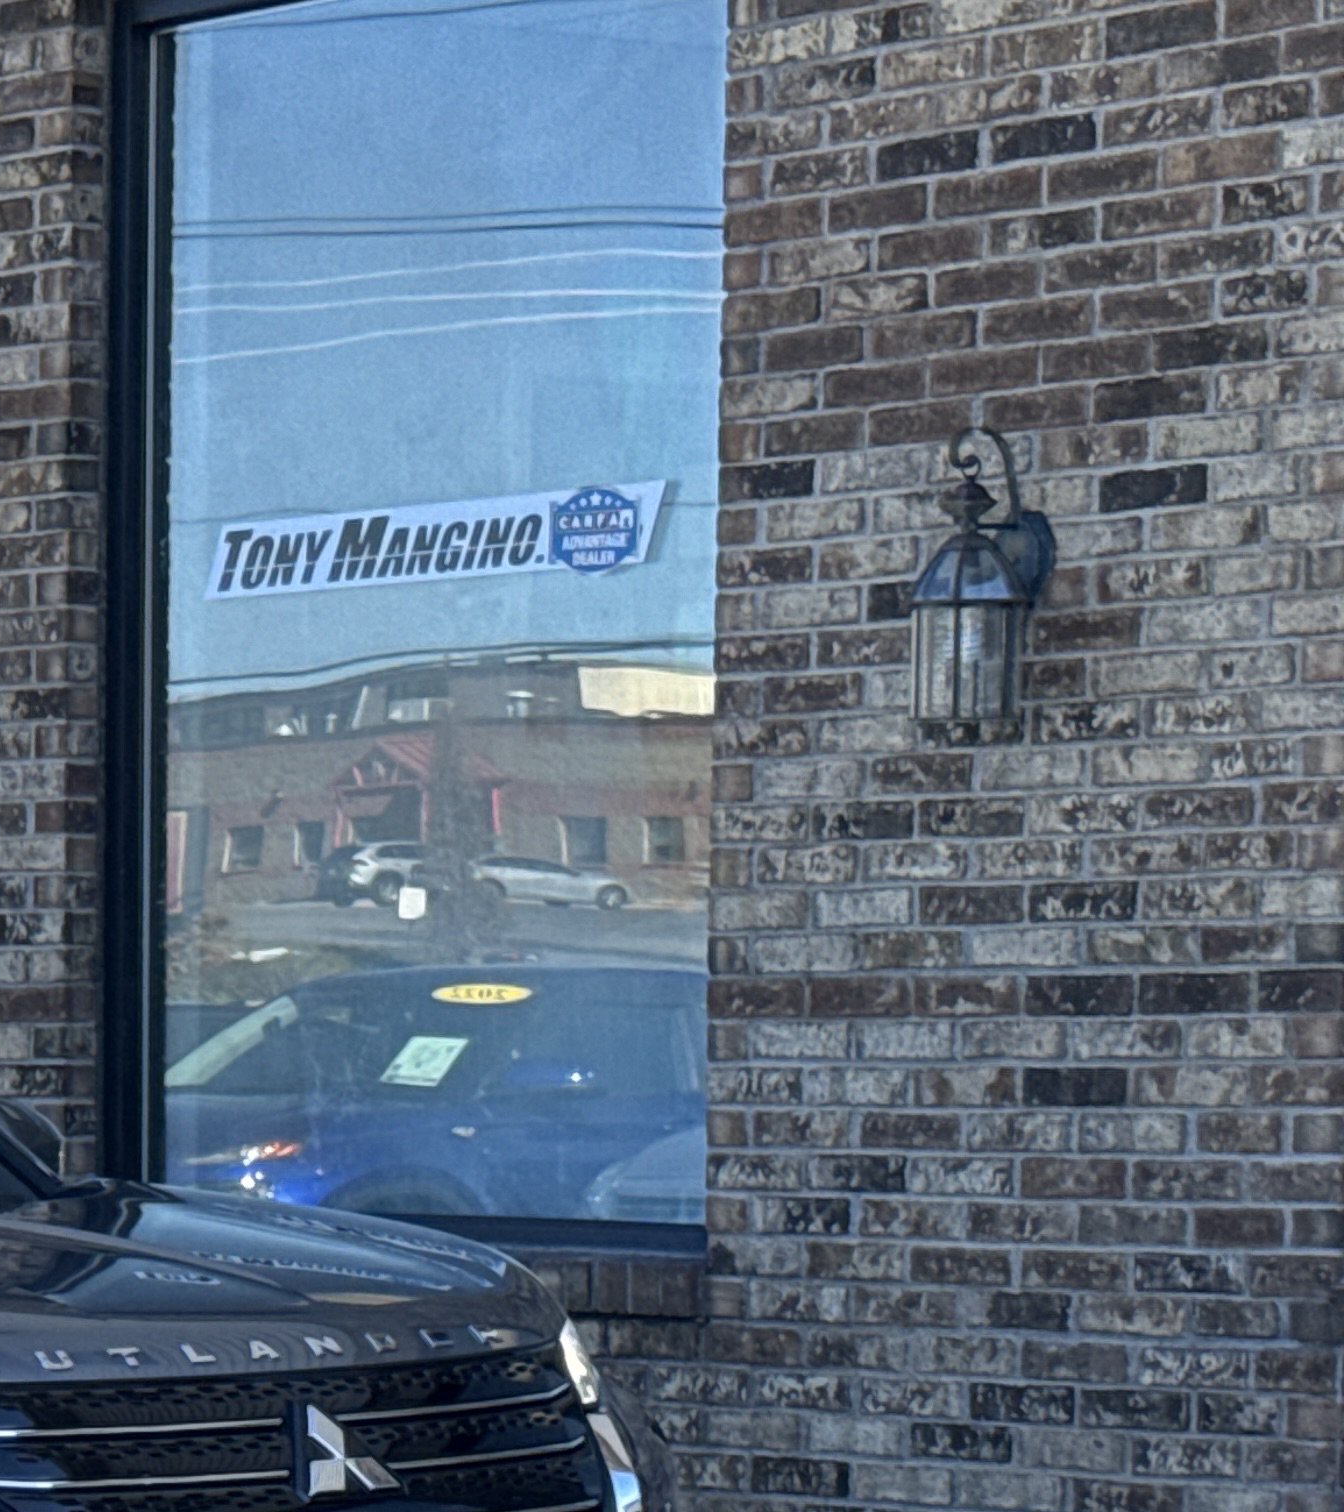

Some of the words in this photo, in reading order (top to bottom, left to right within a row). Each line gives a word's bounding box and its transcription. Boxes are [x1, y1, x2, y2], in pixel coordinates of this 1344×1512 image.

[562, 533, 629, 551] ADVANTAGE
[215, 529, 333, 592] TONY
[571, 550, 616, 566] DEALER
